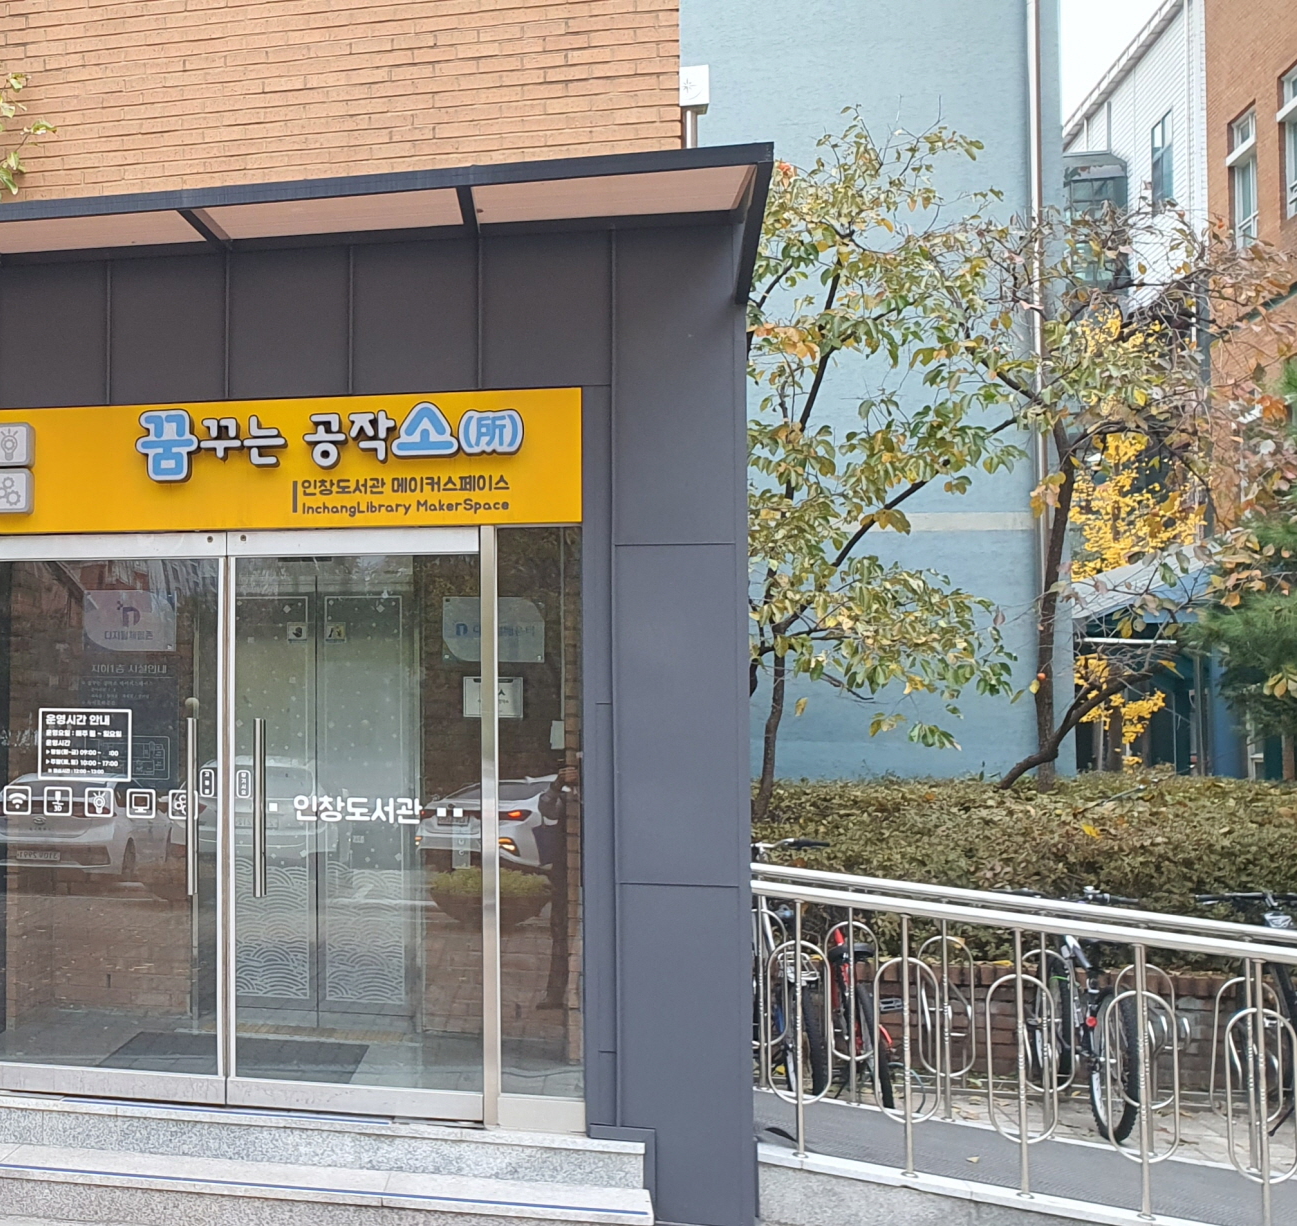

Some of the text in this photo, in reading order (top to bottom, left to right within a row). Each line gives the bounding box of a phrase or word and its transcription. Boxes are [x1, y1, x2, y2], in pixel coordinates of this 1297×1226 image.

[135, 401, 525, 484] 꿈꾸는 공작소(所)
[301, 473, 510, 497] 인창도서관 메이커스페이스
[302, 496, 510, 517] InchangLibrary MakerSpace
[45, 714, 110, 726] 운영시간 안내
[46, 739, 70, 747] 운영시간
[293, 795, 423, 825] 인창도서관
